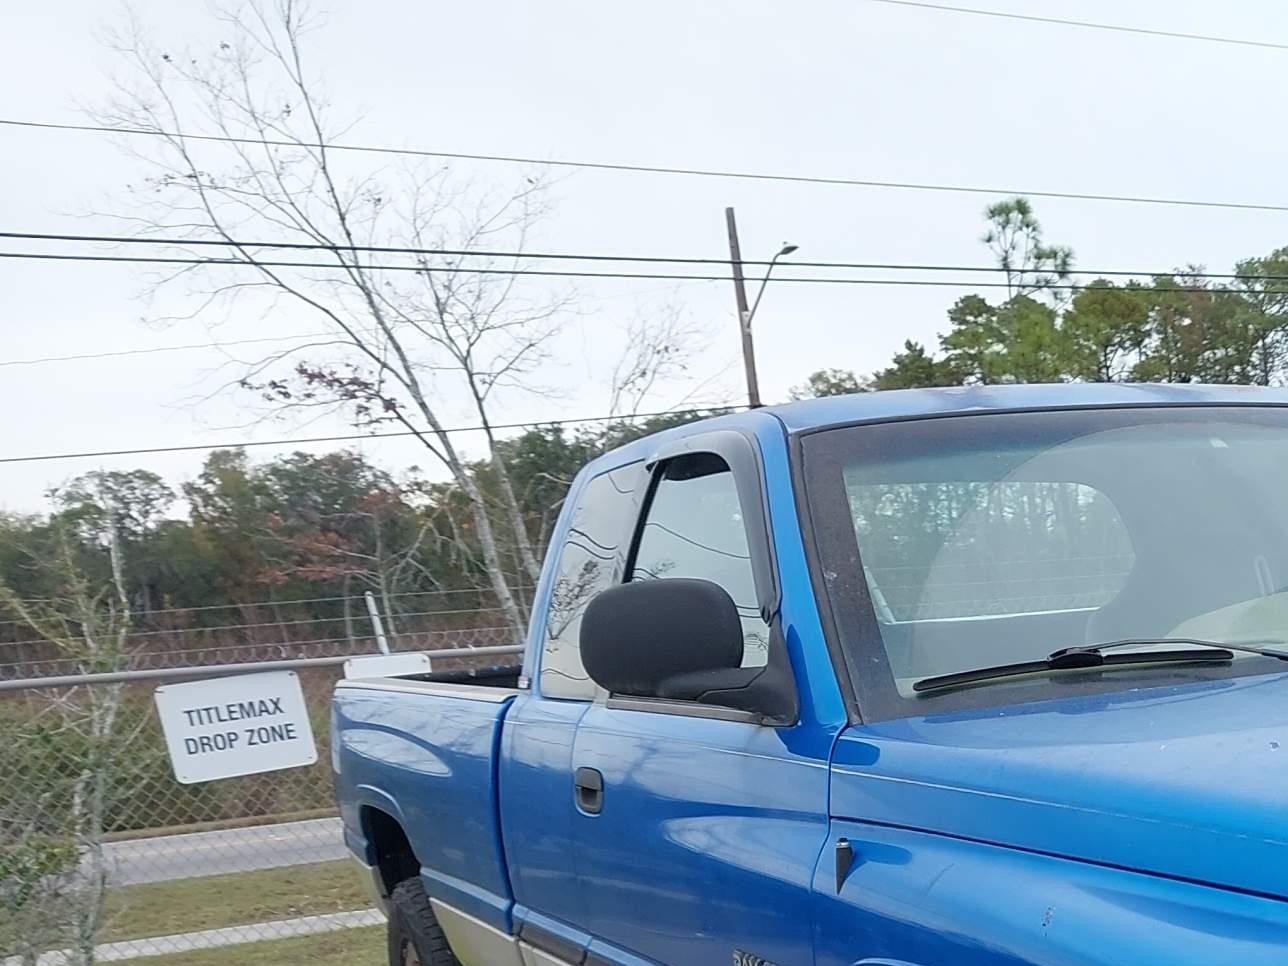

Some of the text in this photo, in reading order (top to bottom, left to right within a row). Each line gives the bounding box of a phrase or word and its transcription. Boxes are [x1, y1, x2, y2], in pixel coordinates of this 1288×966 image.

[182, 697, 285, 726] TITLEMAX
[184, 722, 298, 755] DROP ZONE
